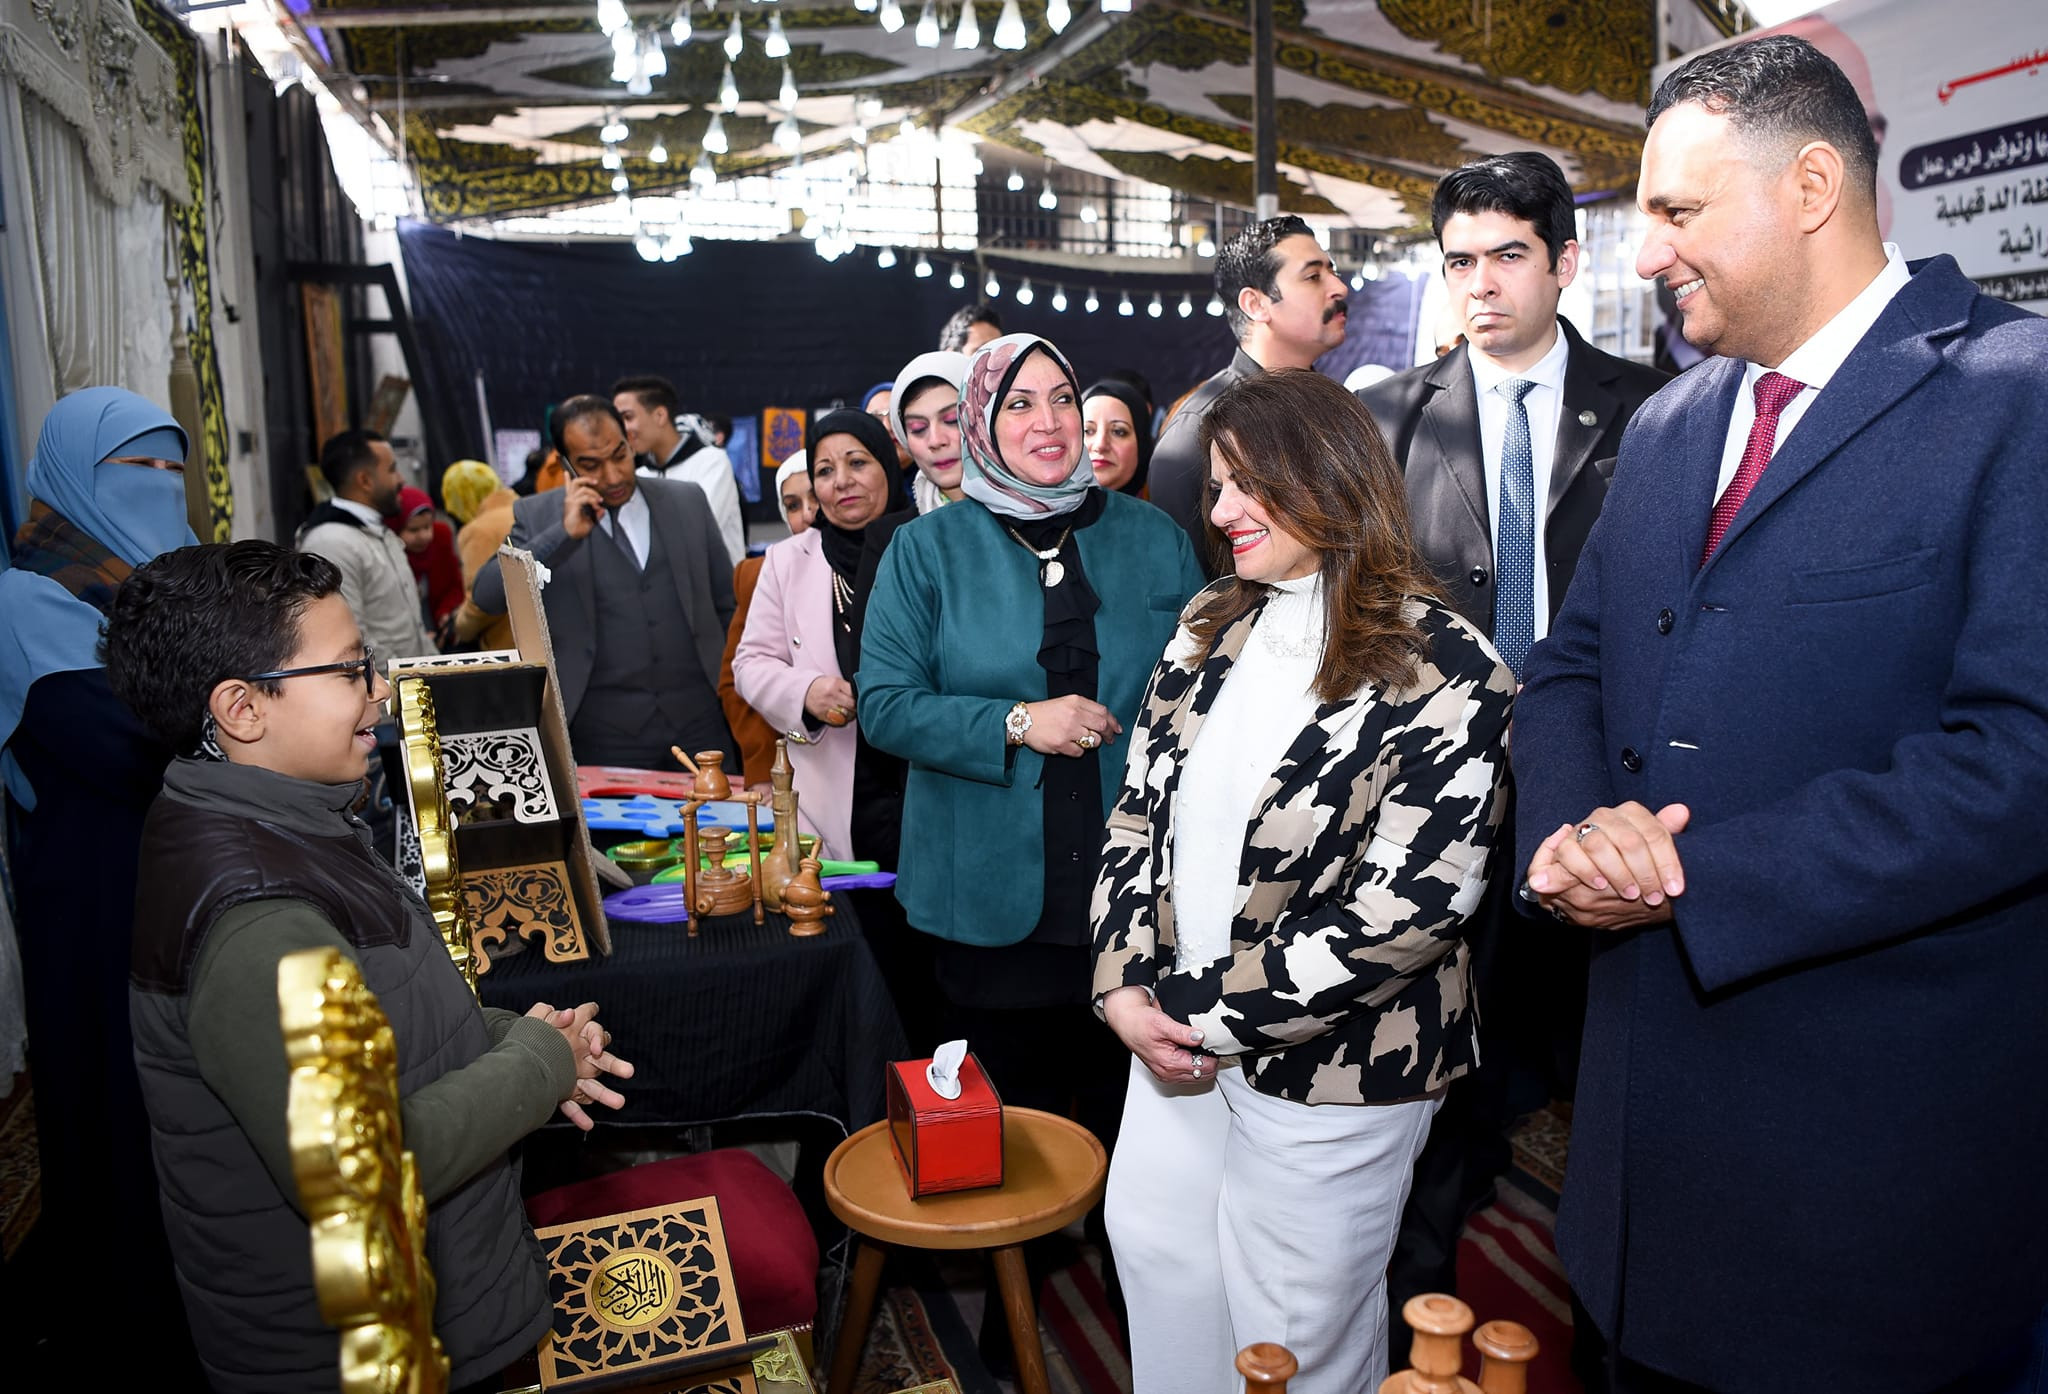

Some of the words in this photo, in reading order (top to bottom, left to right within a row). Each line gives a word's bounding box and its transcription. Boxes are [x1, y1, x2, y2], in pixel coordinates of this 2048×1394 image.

[1915, 155, 1945, 183] عمل
[1945, 140, 1982, 179] فرص
[1983, 130, 2033, 170] وتوفير
[1936, 184, 2018, 228] الدقهلية
[1999, 223, 2048, 263] راثية
